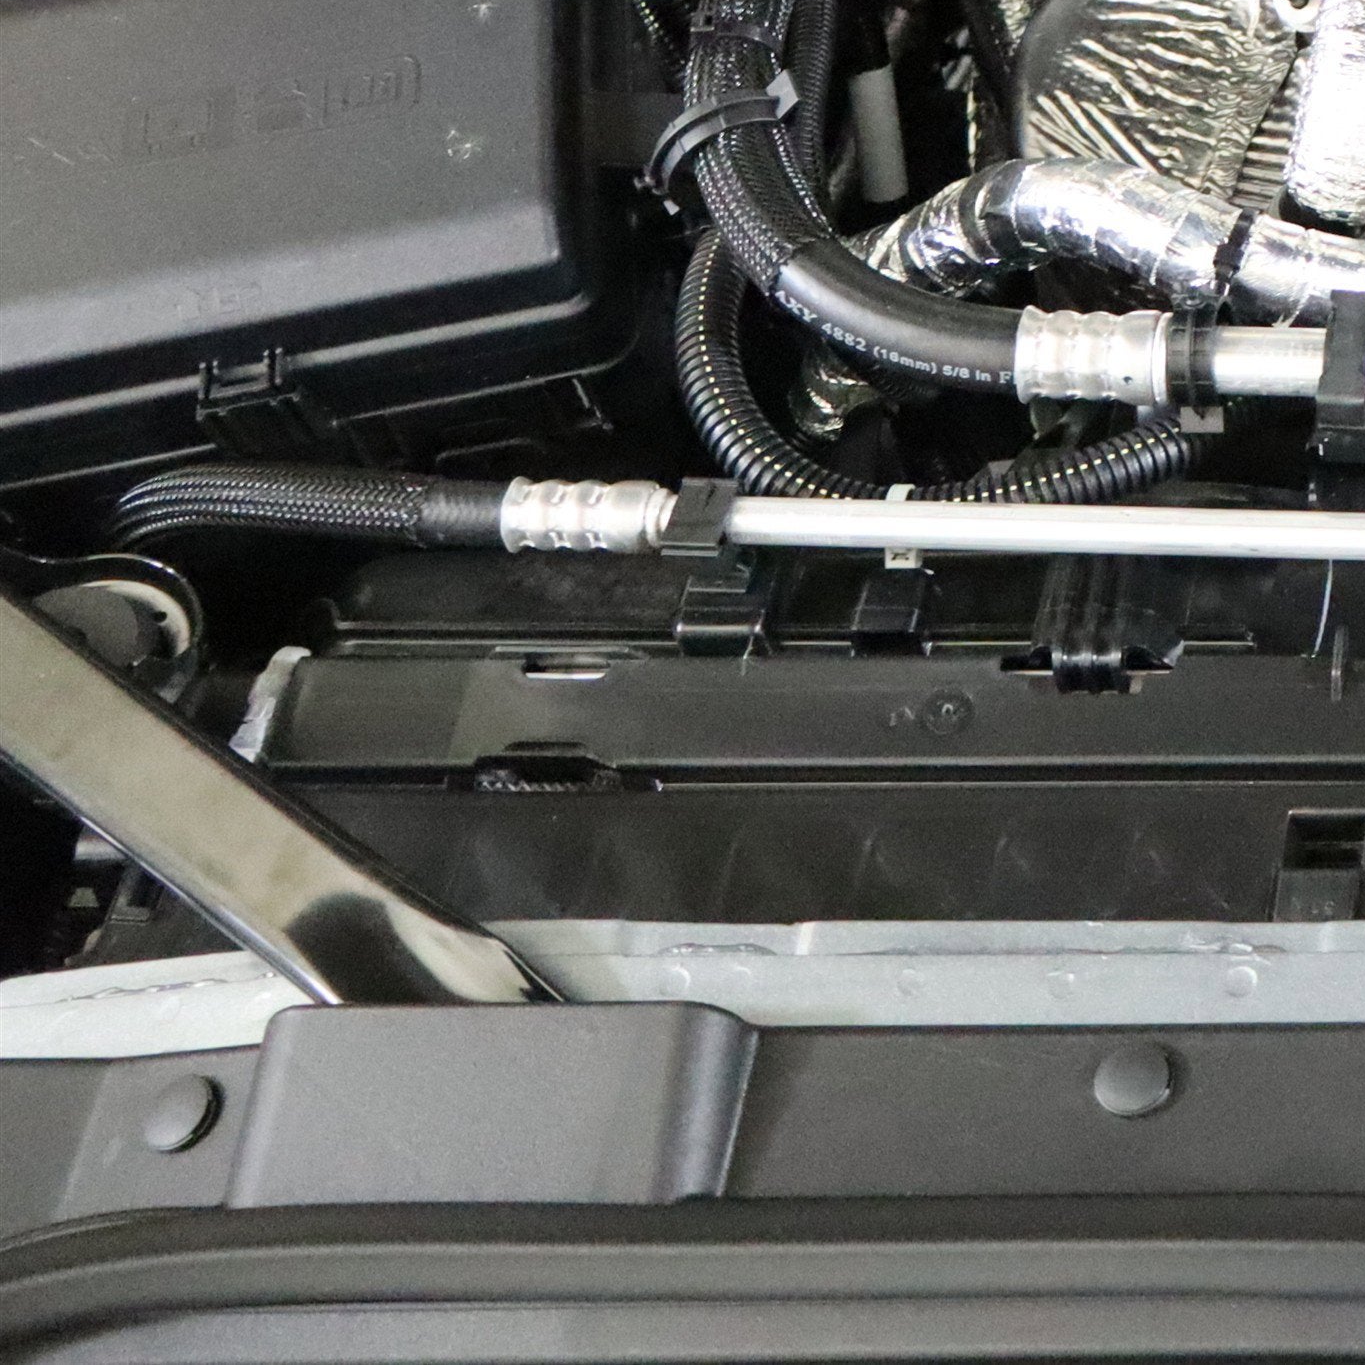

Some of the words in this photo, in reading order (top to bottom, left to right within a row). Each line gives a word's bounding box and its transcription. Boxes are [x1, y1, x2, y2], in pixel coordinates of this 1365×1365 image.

[821, 322, 868, 352] 4882
[873, 345, 937, 375] (16mm)
[942, 365, 970, 380] 5/8
